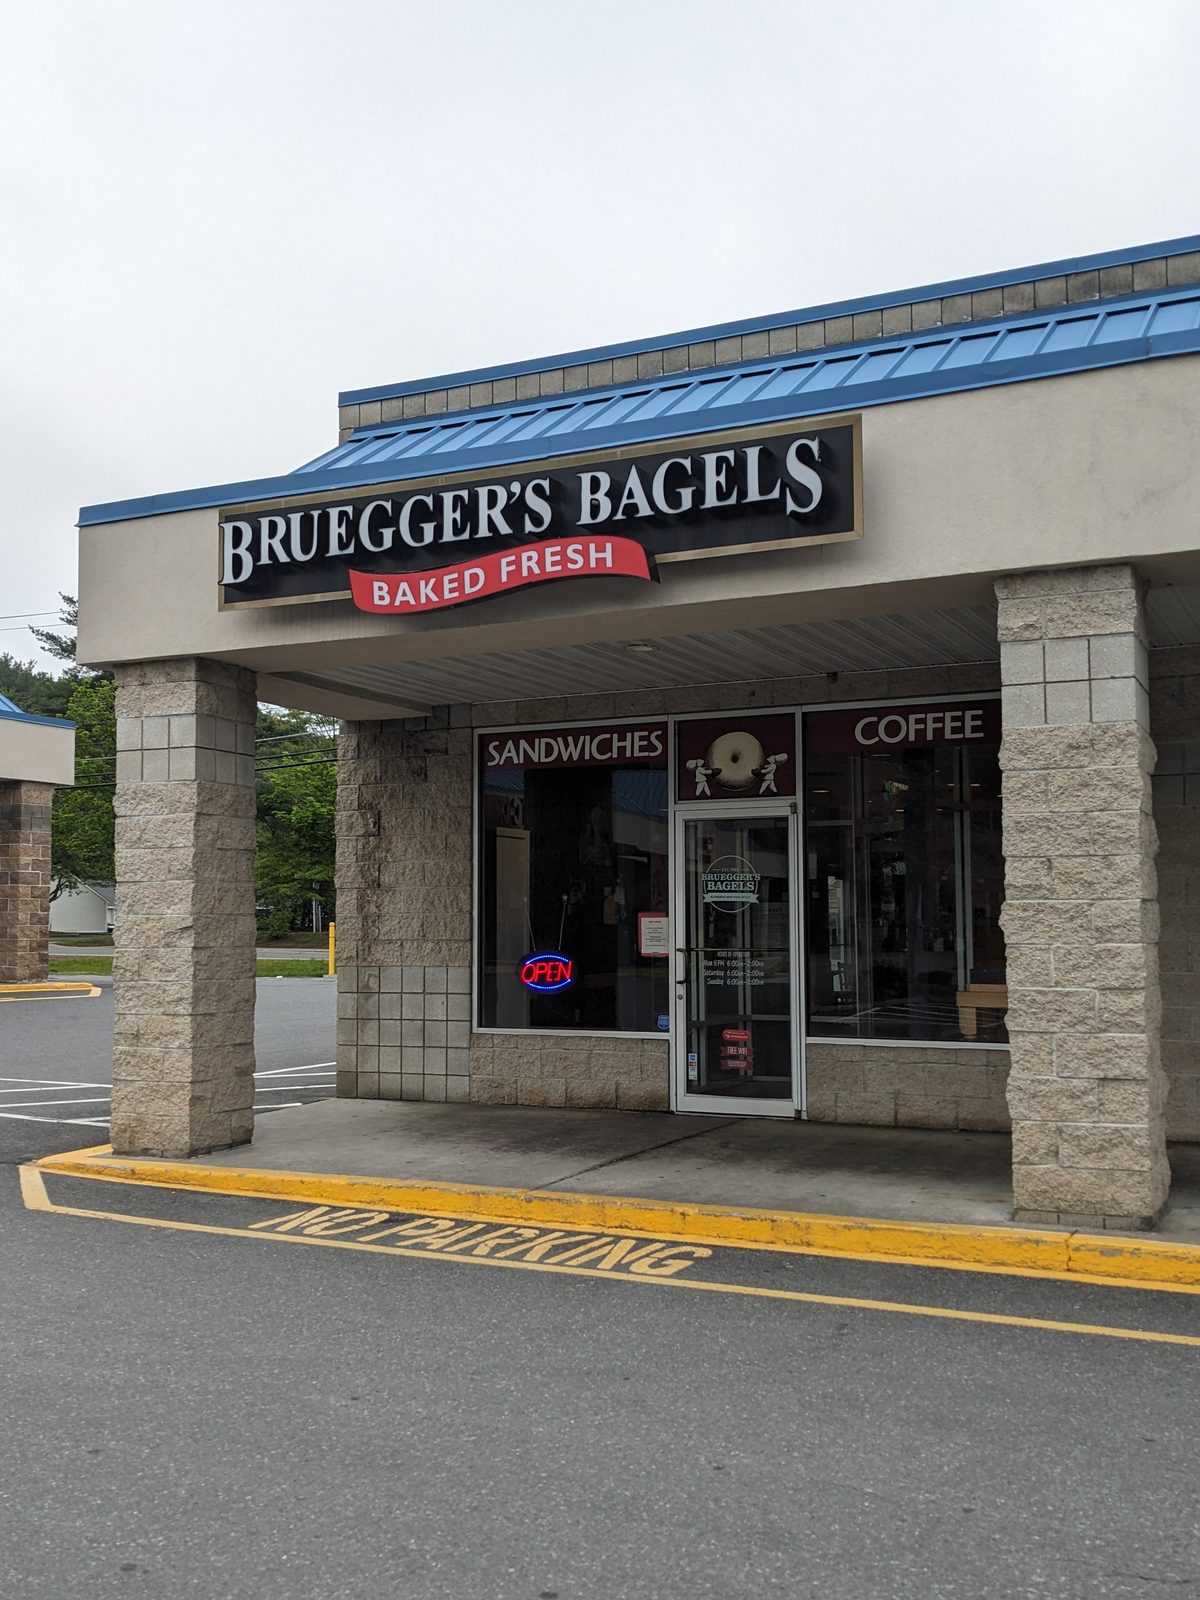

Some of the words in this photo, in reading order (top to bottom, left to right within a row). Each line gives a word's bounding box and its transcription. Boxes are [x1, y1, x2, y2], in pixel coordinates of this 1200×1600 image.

[219, 477, 551, 585] BRUEGGER'S
[576, 435, 823, 516] BAGELS
[373, 568, 485, 606] BAKED
[501, 542, 612, 583] FRESH
[854, 709, 984, 745] COFFEE
[487, 730, 663, 767] SANDWICHES
[702, 873, 761, 881] BRUEGGER'S
[707, 881, 755, 891] BAGELS
[521, 961, 572, 983] OPEN
[247, 1206, 390, 1236] NO
[358, 1218, 713, 1275] PARKING
